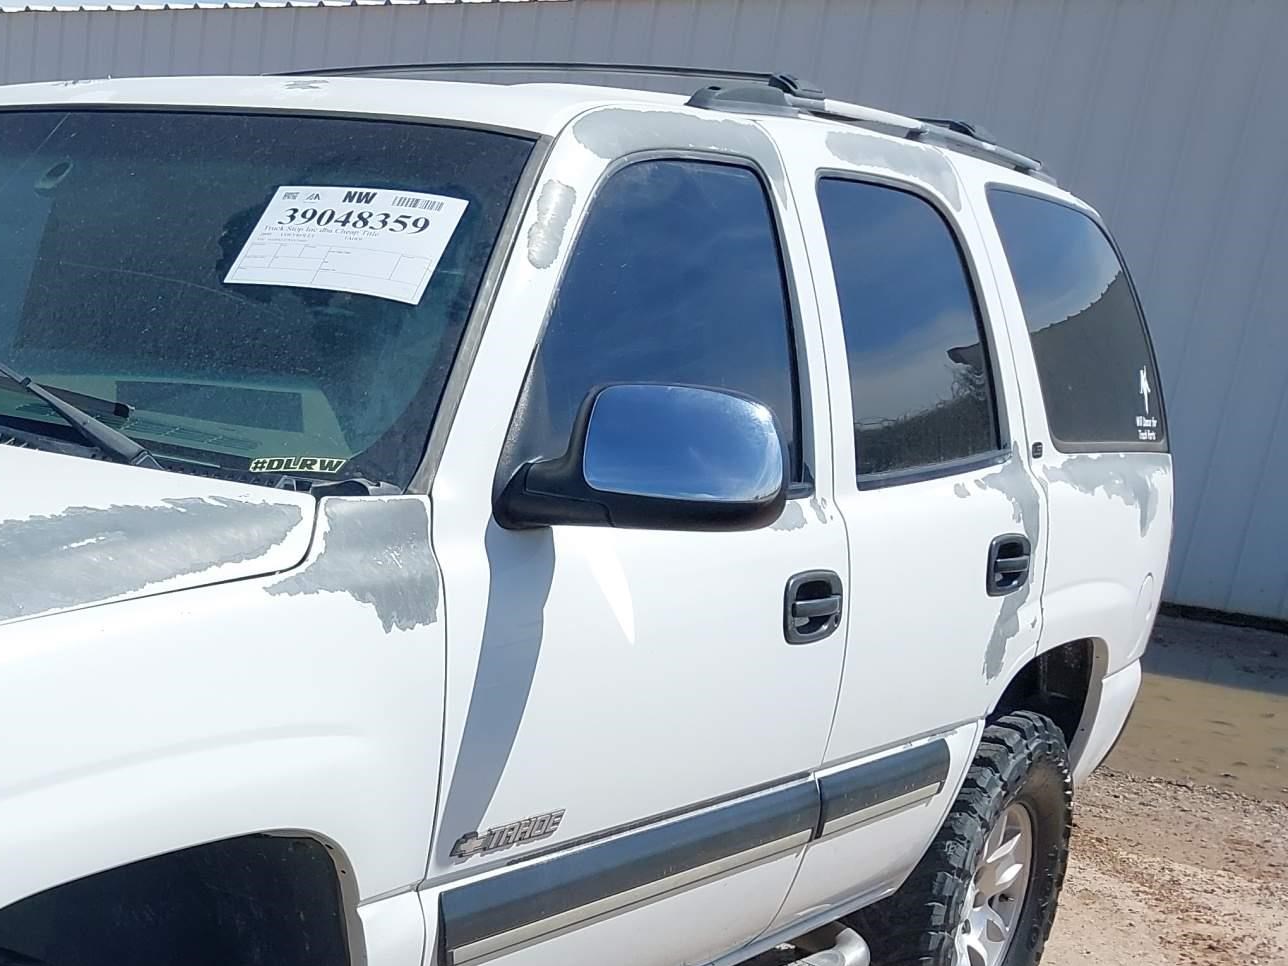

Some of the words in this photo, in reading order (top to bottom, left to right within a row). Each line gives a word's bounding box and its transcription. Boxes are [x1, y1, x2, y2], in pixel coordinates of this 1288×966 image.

[342, 191, 377, 204] NW
[277, 208, 430, 234] 39048359
[252, 458, 344, 472] #DLRW
[488, 811, 566, 849] TAHOE
